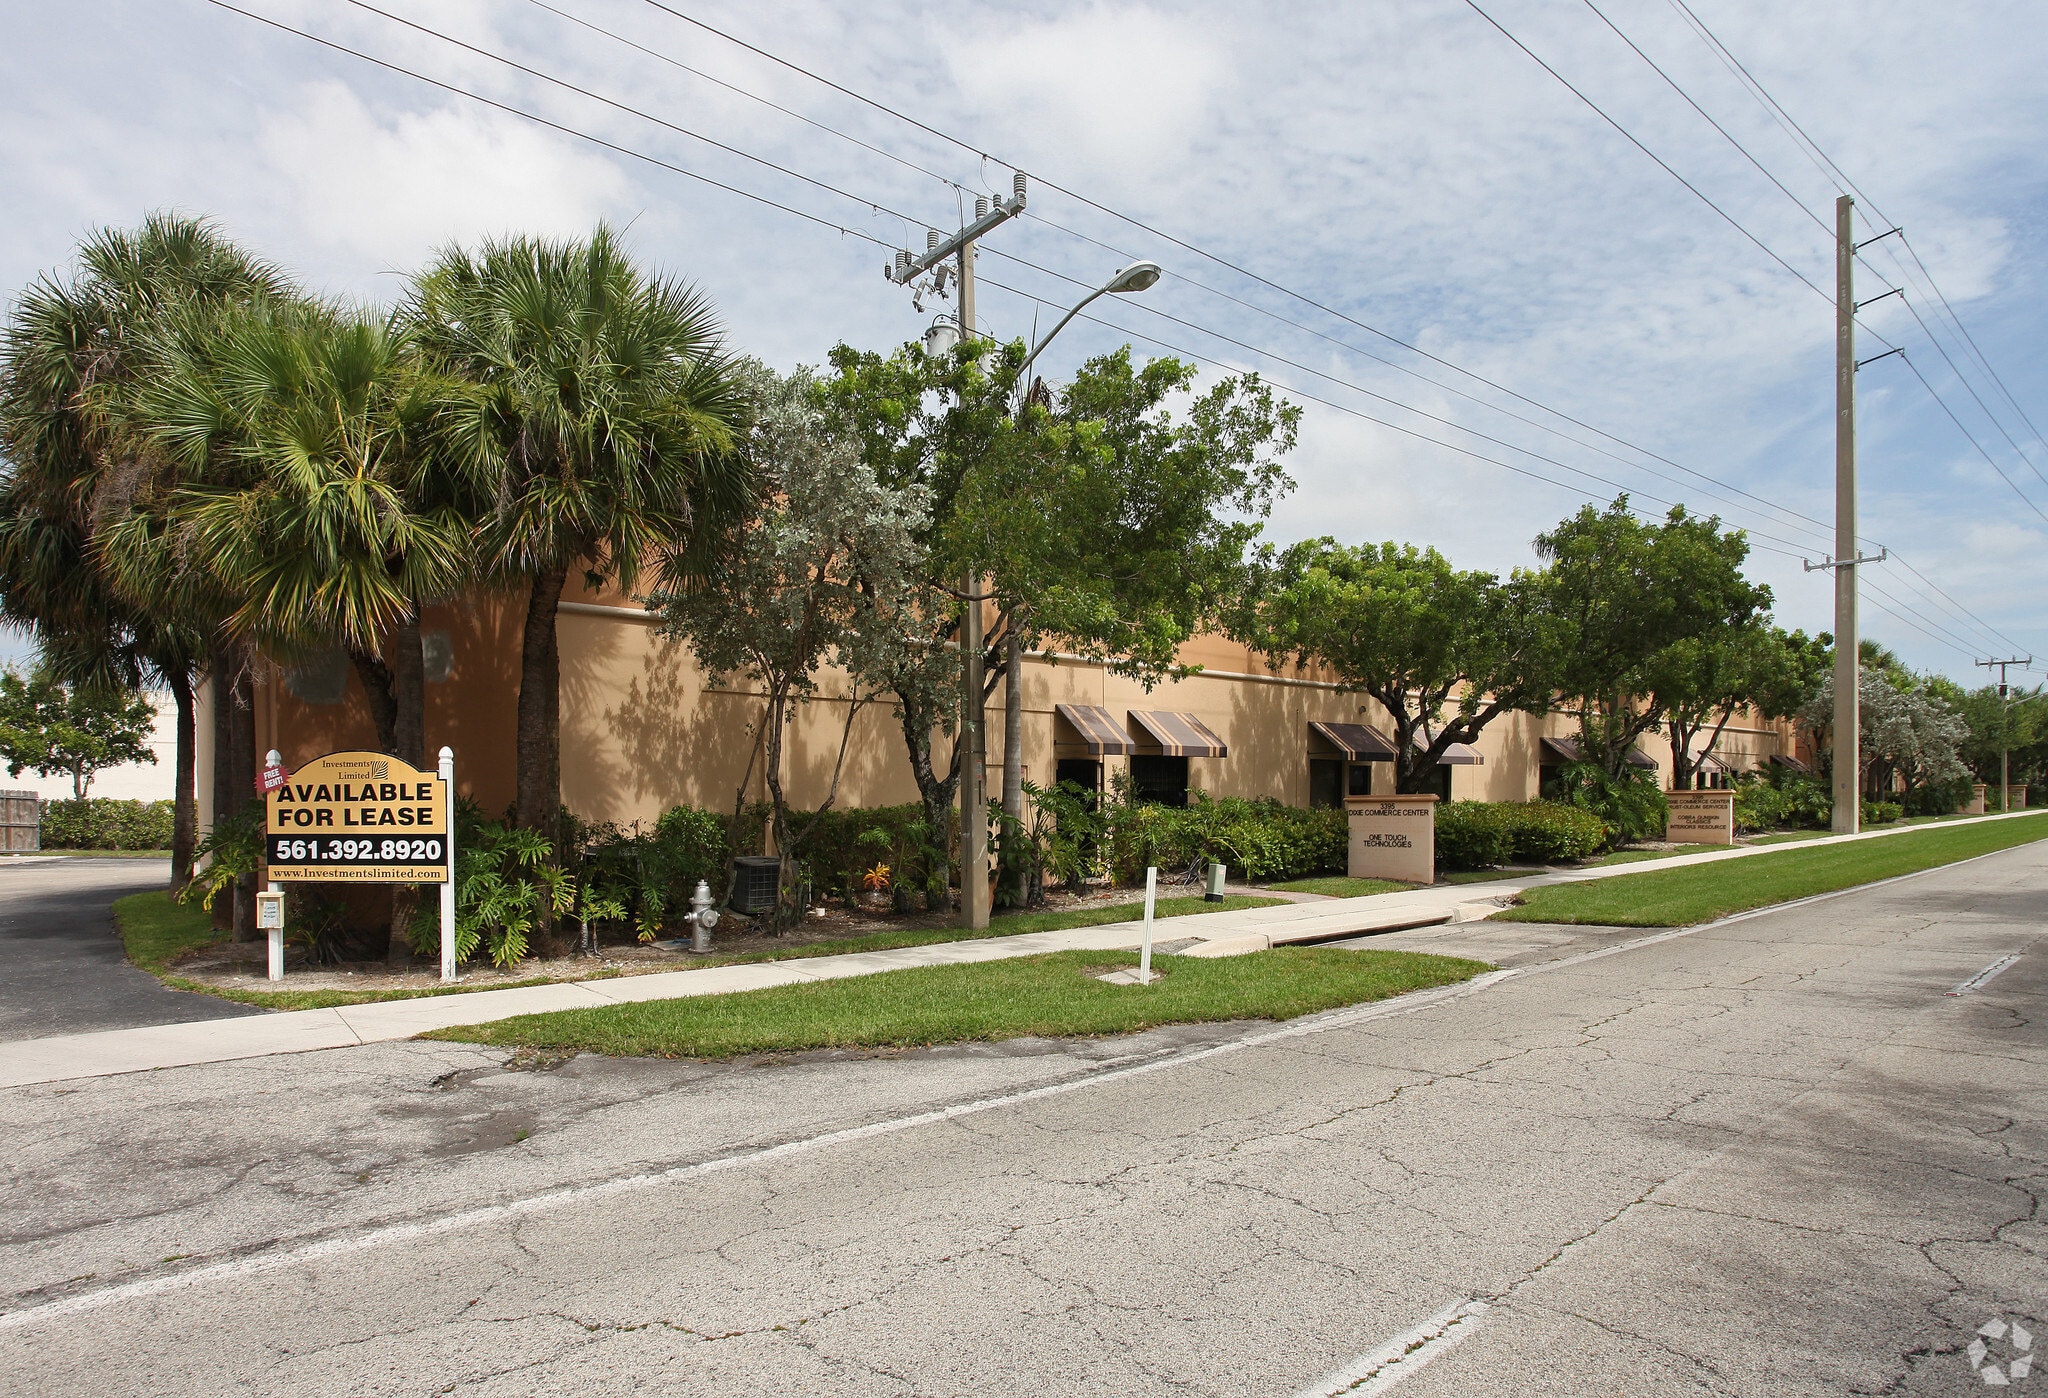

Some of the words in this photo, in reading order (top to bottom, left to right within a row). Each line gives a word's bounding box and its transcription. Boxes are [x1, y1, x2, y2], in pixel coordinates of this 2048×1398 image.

[322, 760, 370, 768] Investments
[263, 768, 280, 780] FREE
[338, 772, 370, 780] Limited
[264, 776, 284, 789] RENT!
[276, 783, 433, 802] AVAILABLE
[278, 808, 334, 827] FOR
[344, 807, 434, 826] LEASE
[276, 840, 441, 860] 561.392.8920
[273, 868, 441, 879] www.Investmentslimited.com
